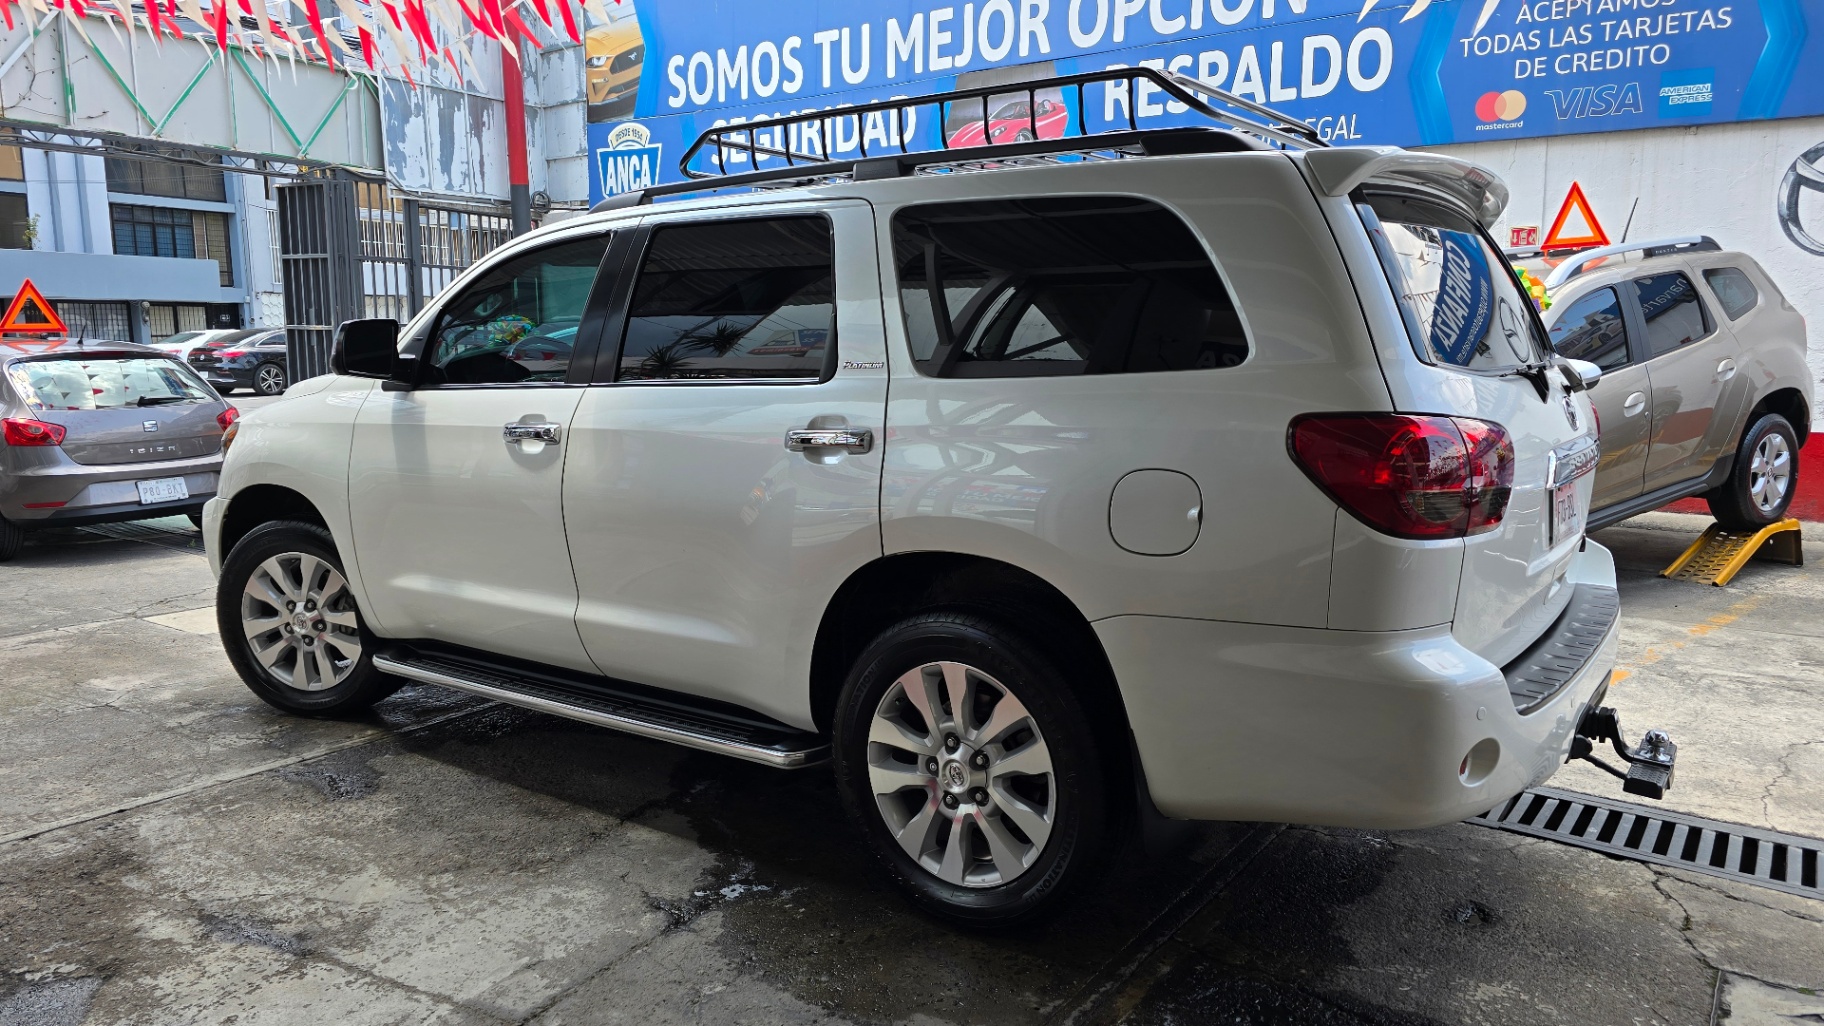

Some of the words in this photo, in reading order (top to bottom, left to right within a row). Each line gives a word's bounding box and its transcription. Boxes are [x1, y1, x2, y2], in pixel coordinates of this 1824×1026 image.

[1515, 0, 1675, 25] ACEPTAM
[1460, 30, 1541, 57] TODAS
[1549, 24, 1592, 48] LAS
[1600, 7, 1732, 41] TARJETAS
[667, 36, 803, 108] SOMOS
[813, 27, 869, 88] TU
[886, 0, 1051, 79] MEJOR
[1068, 0, 1307, 48] OPCI
[1515, 57, 1547, 79] DE
[1554, 44, 1670, 75] CREDITO
[710, 95, 917, 166] SEGURIDAD
[1105, 27, 1393, 121] RESPALDO
[1543, 82, 1643, 120] VISA
[1659, 83, 1712, 97] AMERICAN
[1669, 93, 1713, 105] EXPRESS
[1475, 120, 1524, 131] mastercard
[605, 154, 652, 195] ANCA
